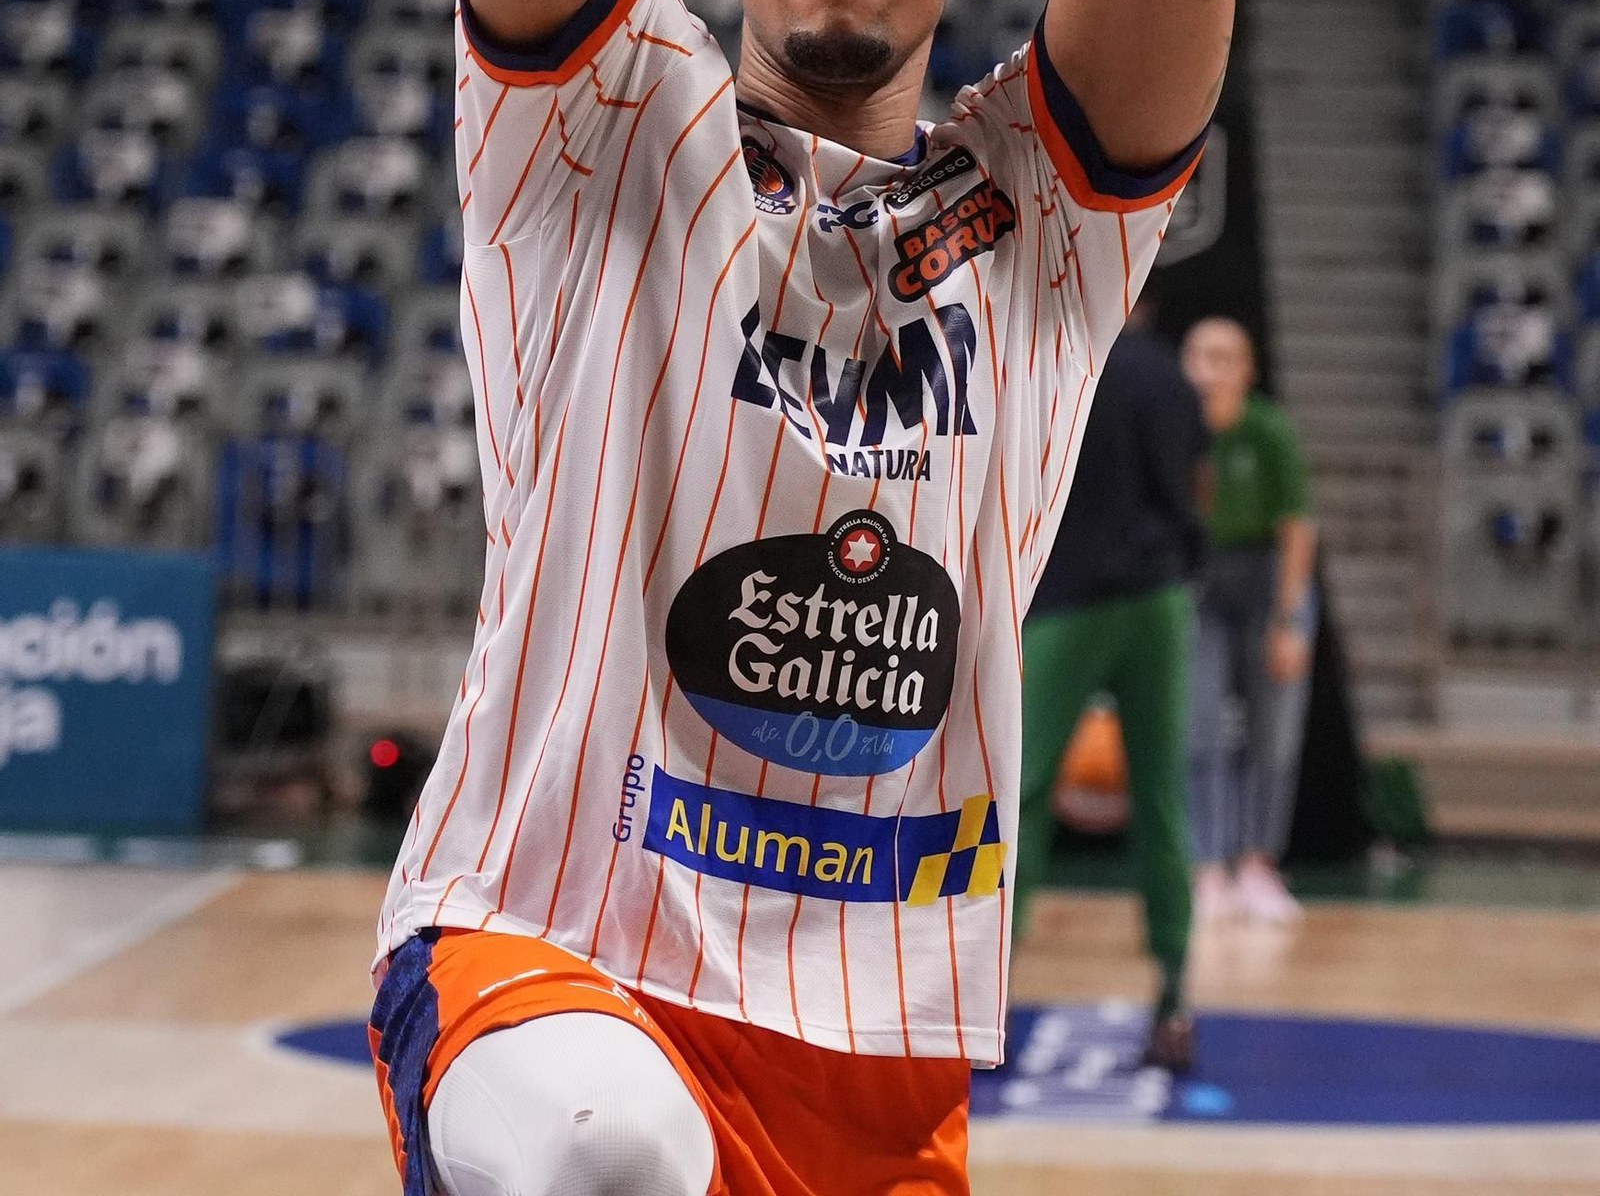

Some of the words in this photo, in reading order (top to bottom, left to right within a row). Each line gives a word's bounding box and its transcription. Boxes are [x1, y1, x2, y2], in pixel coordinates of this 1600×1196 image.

[903, 187, 993, 259] BASQU
[826, 449, 932, 482] NATURA
[834, 518, 861, 539] ESTRELLA
[861, 517, 884, 534] GALICIA
[827, 550, 856, 584] CERVECEROS
[857, 571, 879, 584] DESDE
[728, 569, 939, 653] Estrella
[728, 633, 925, 716] Galicia
[785, 710, 859, 763] 0,0
[612, 753, 646, 843] Grupo
[664, 796, 875, 885] Aluman
